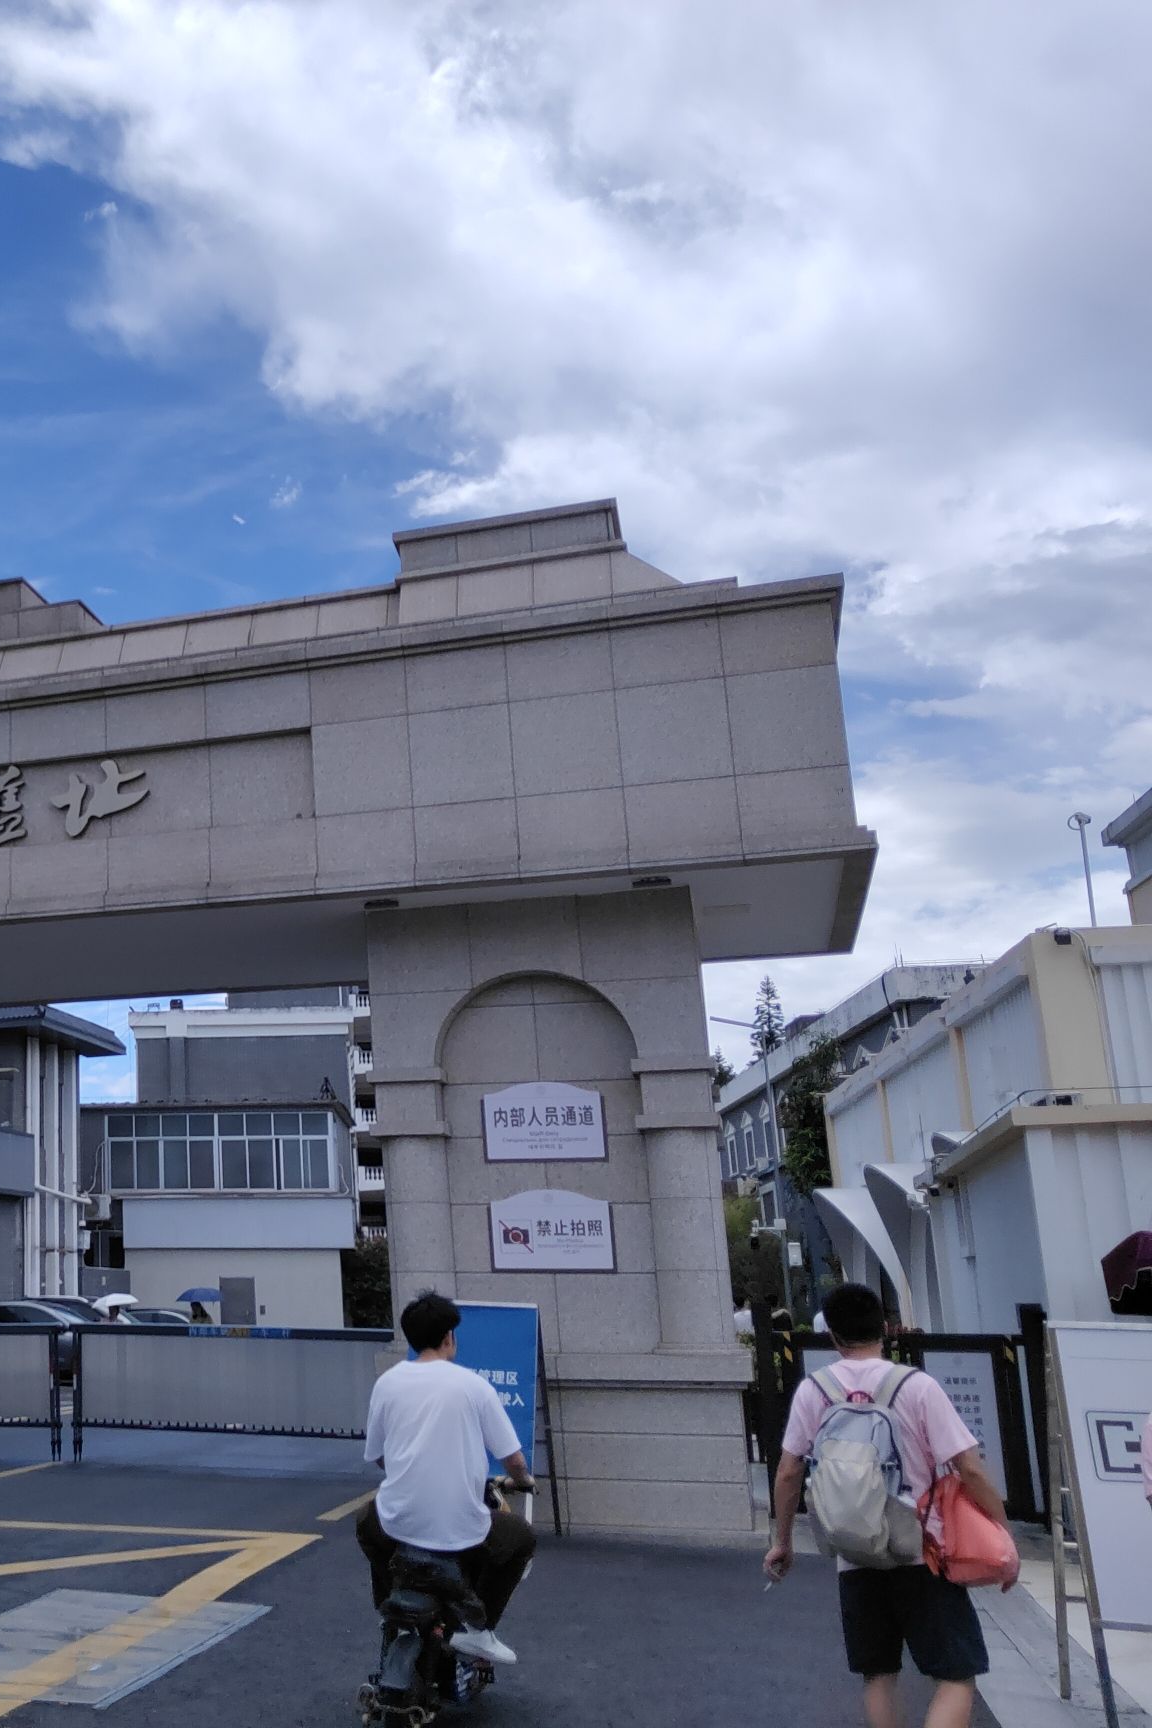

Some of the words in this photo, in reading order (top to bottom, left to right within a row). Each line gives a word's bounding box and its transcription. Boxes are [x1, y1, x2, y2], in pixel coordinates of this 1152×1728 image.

[493, 1105, 595, 1128] 内部人员通道
[536, 1219, 603, 1237] 禁止拍照
[472, 1368, 519, 1386] 管理区
